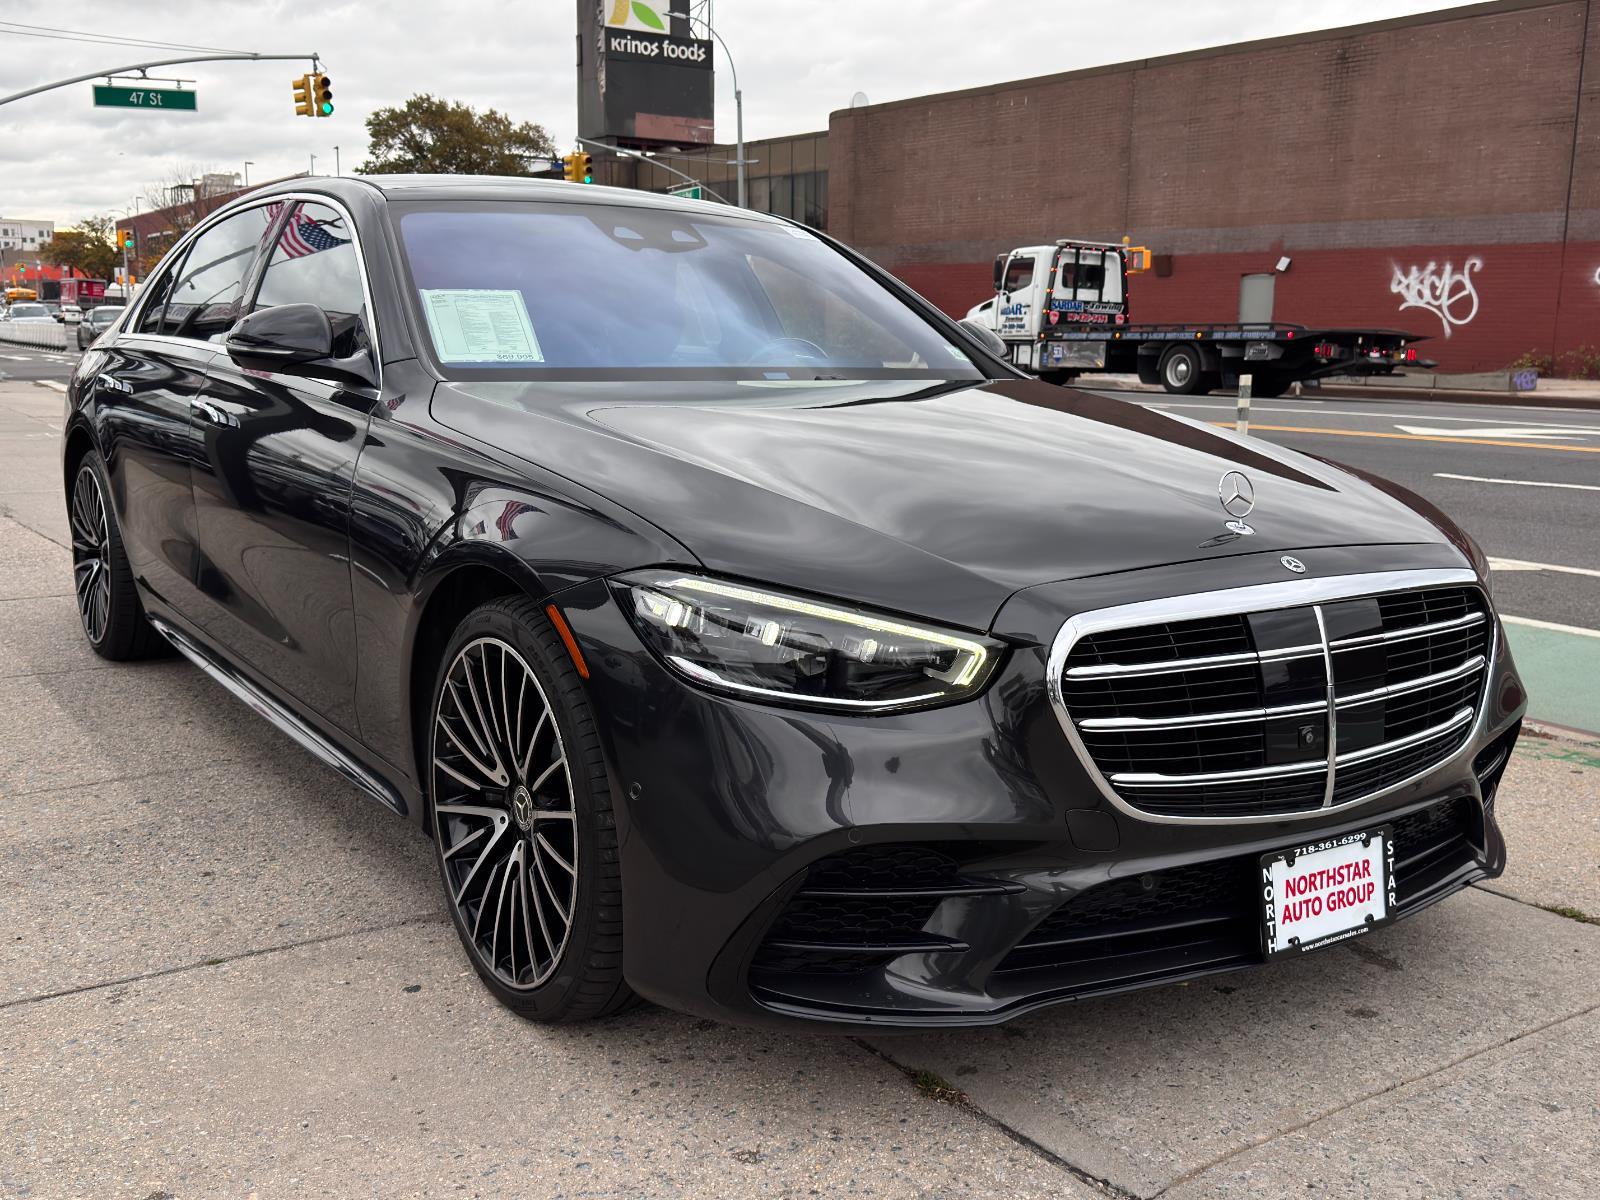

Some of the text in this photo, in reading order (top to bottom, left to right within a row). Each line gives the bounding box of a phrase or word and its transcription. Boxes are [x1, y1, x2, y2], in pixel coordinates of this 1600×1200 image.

[662, 40, 706, 62] foods
[129, 92, 162, 106] 47 St
[1294, 832, 1367, 857] 718-361-6299
[1285, 859, 1371, 899] NORTHSTAR
[1386, 840, 1397, 907] STAR
[1262, 867, 1278, 954] NORTH
[1281, 882, 1375, 926] AUTO GROUP
